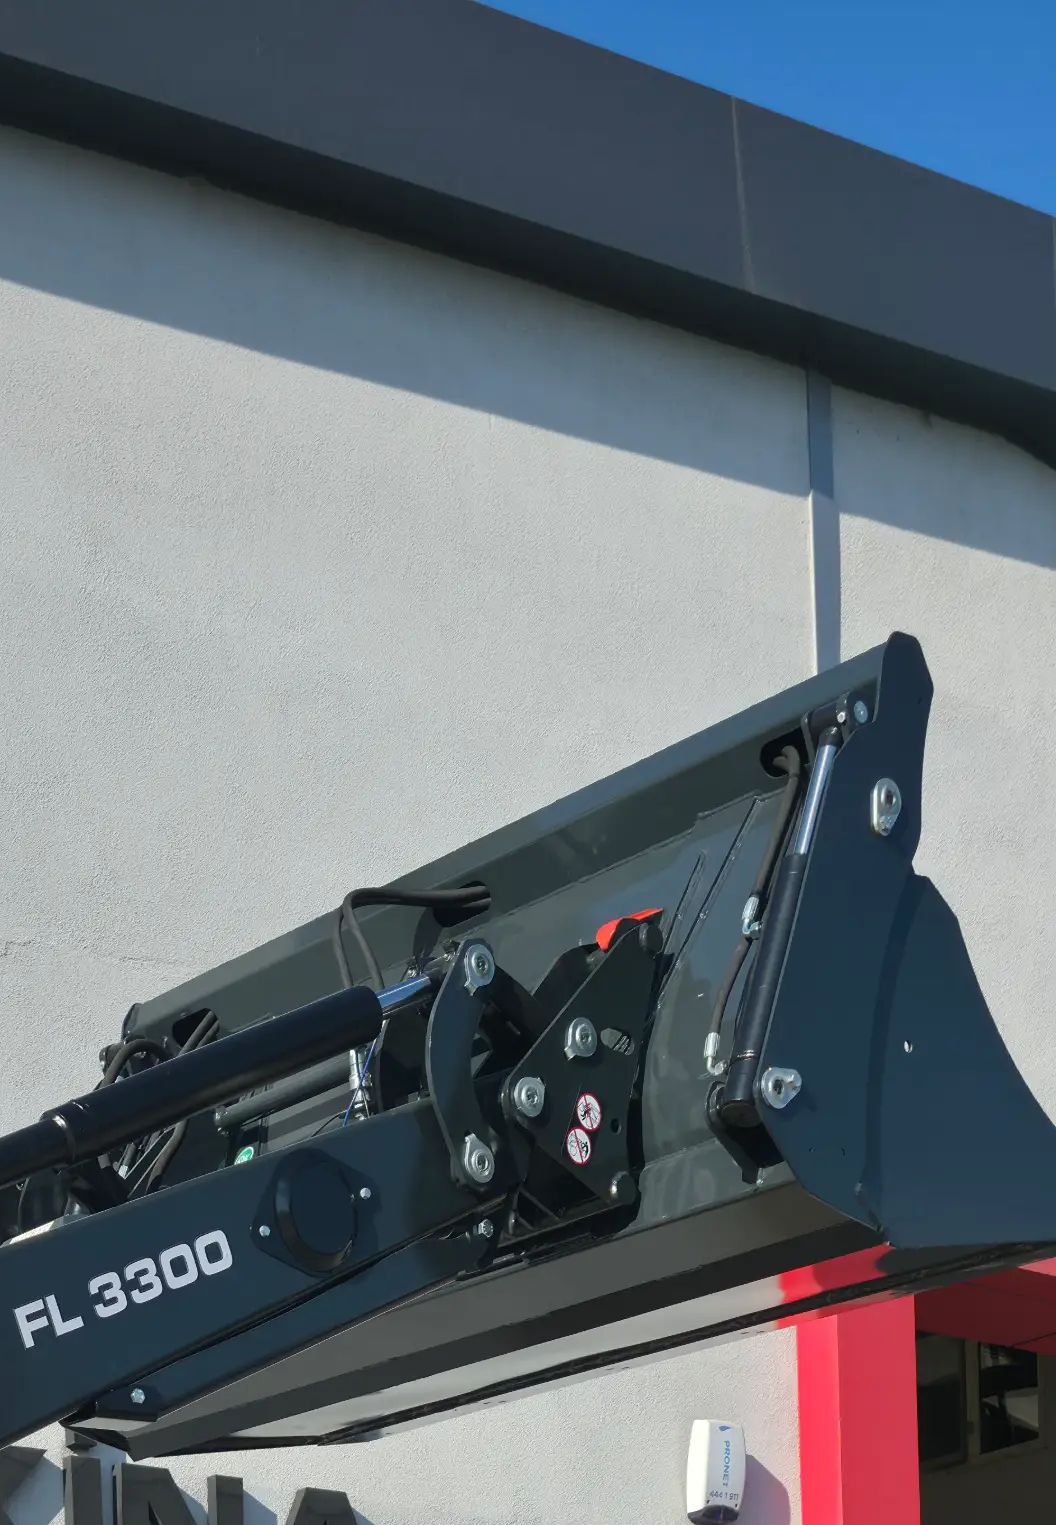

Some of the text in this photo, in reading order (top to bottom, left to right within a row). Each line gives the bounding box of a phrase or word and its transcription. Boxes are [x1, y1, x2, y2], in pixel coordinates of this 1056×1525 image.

[14, 1230, 233, 1349] FL 3300
[722, 1440, 731, 1487] PRONET
